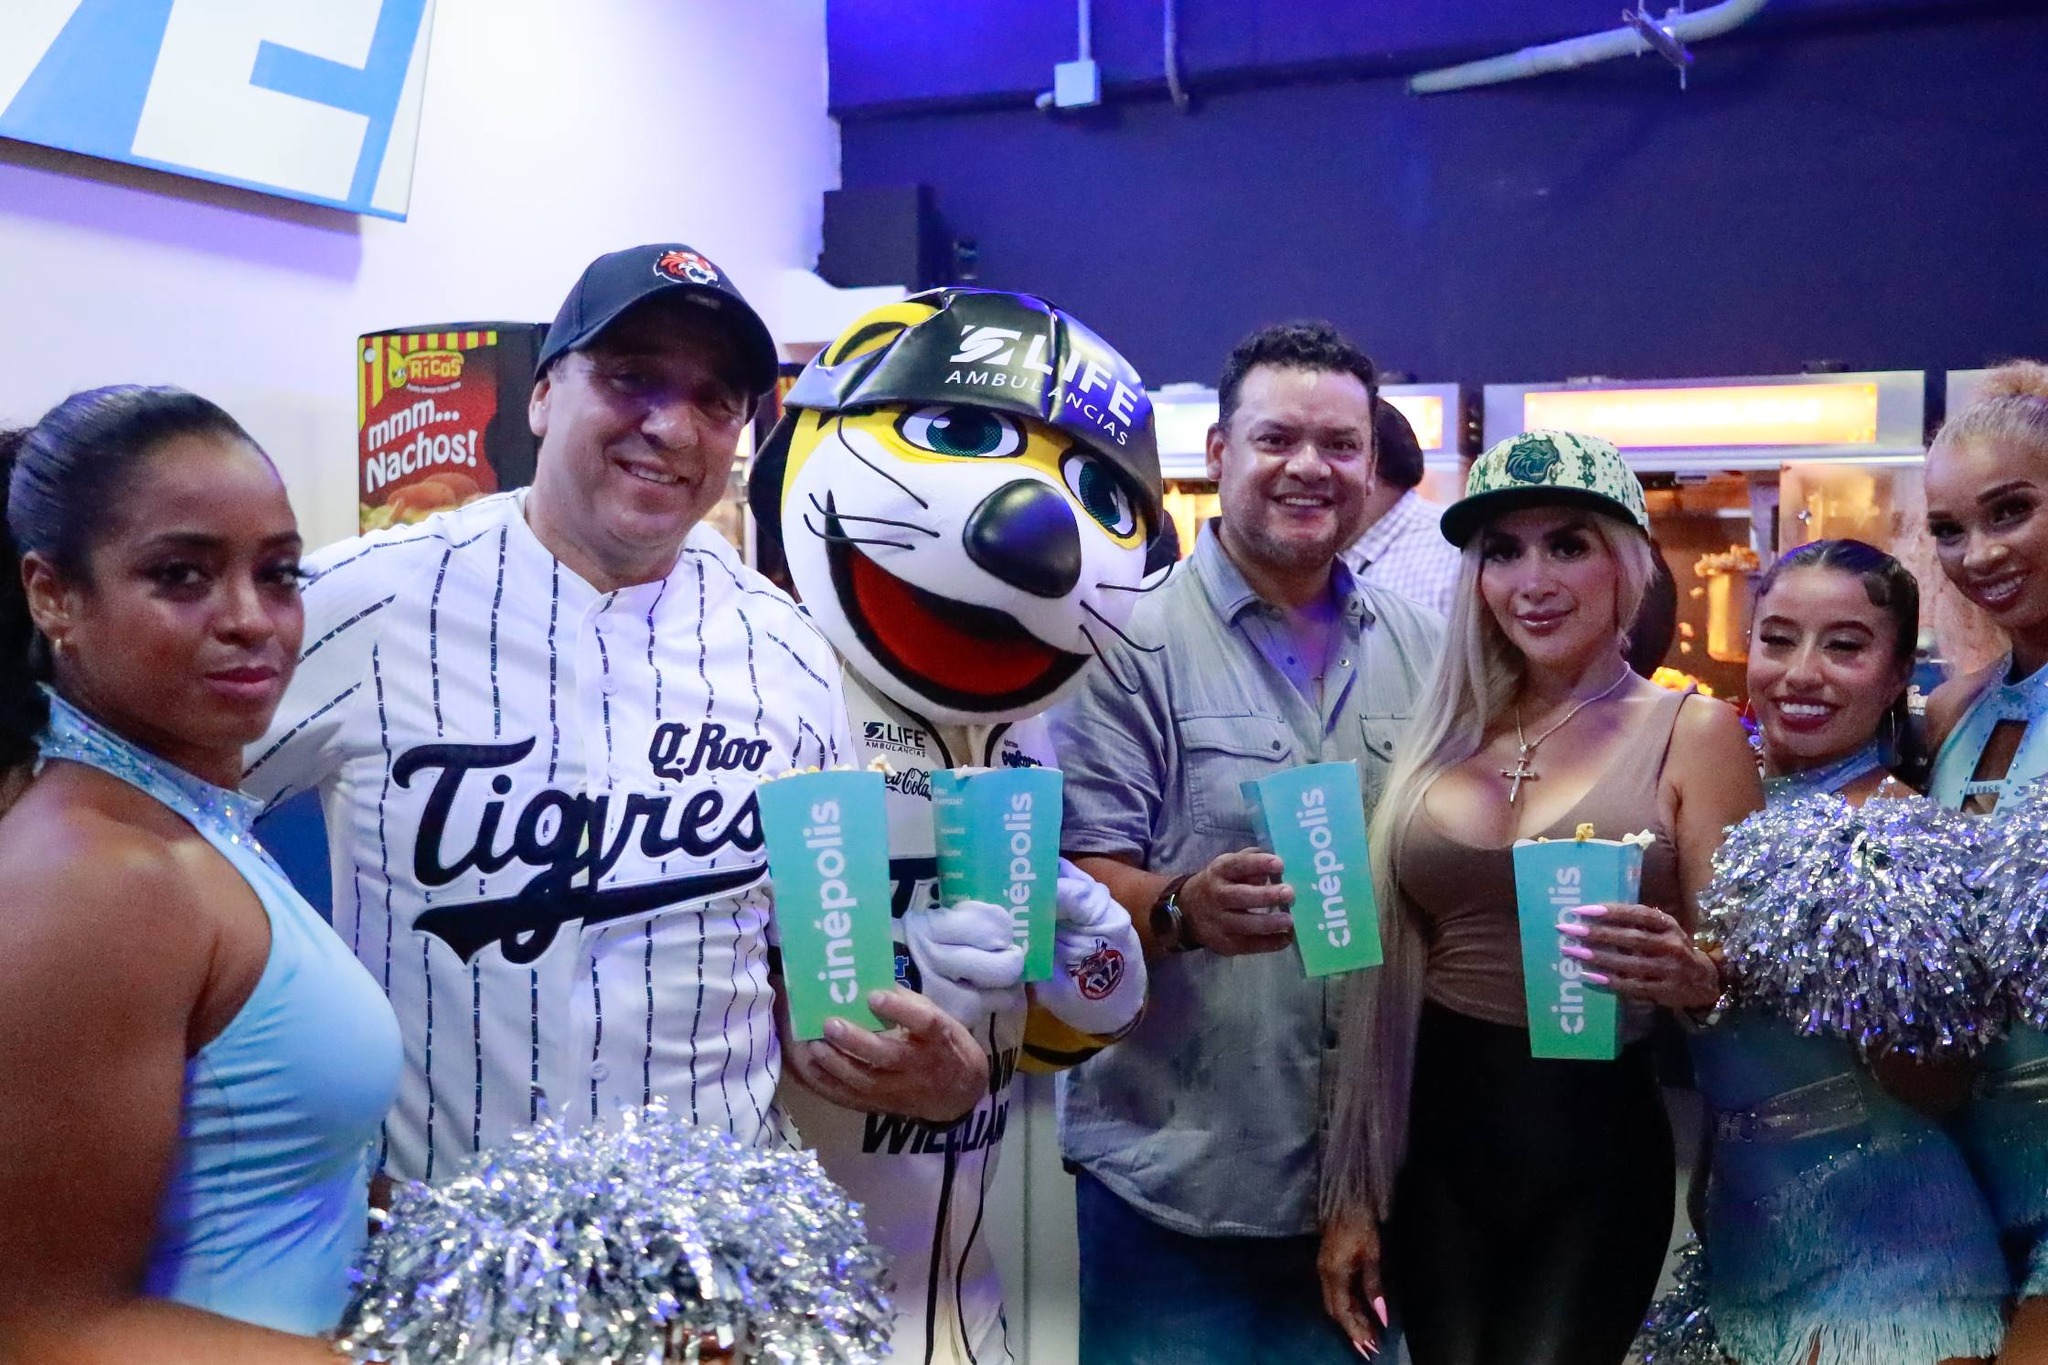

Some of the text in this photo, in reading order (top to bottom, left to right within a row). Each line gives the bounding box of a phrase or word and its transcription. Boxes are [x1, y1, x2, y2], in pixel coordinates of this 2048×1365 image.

[945, 370, 1129, 446] AMBULANCIAS
[1022, 334, 1138, 428] LIFE
[368, 399, 460, 451] mmm...
[366, 429, 478, 494] Nachos!
[649, 722, 773, 784] Q.Roo
[865, 741, 926, 758] AMBULANCIAS
[887, 724, 927, 749] LIFE
[392, 736, 768, 965] Tigres
[1296, 787, 1351, 948] cinépolis
[803, 799, 859, 1004] cinépolis
